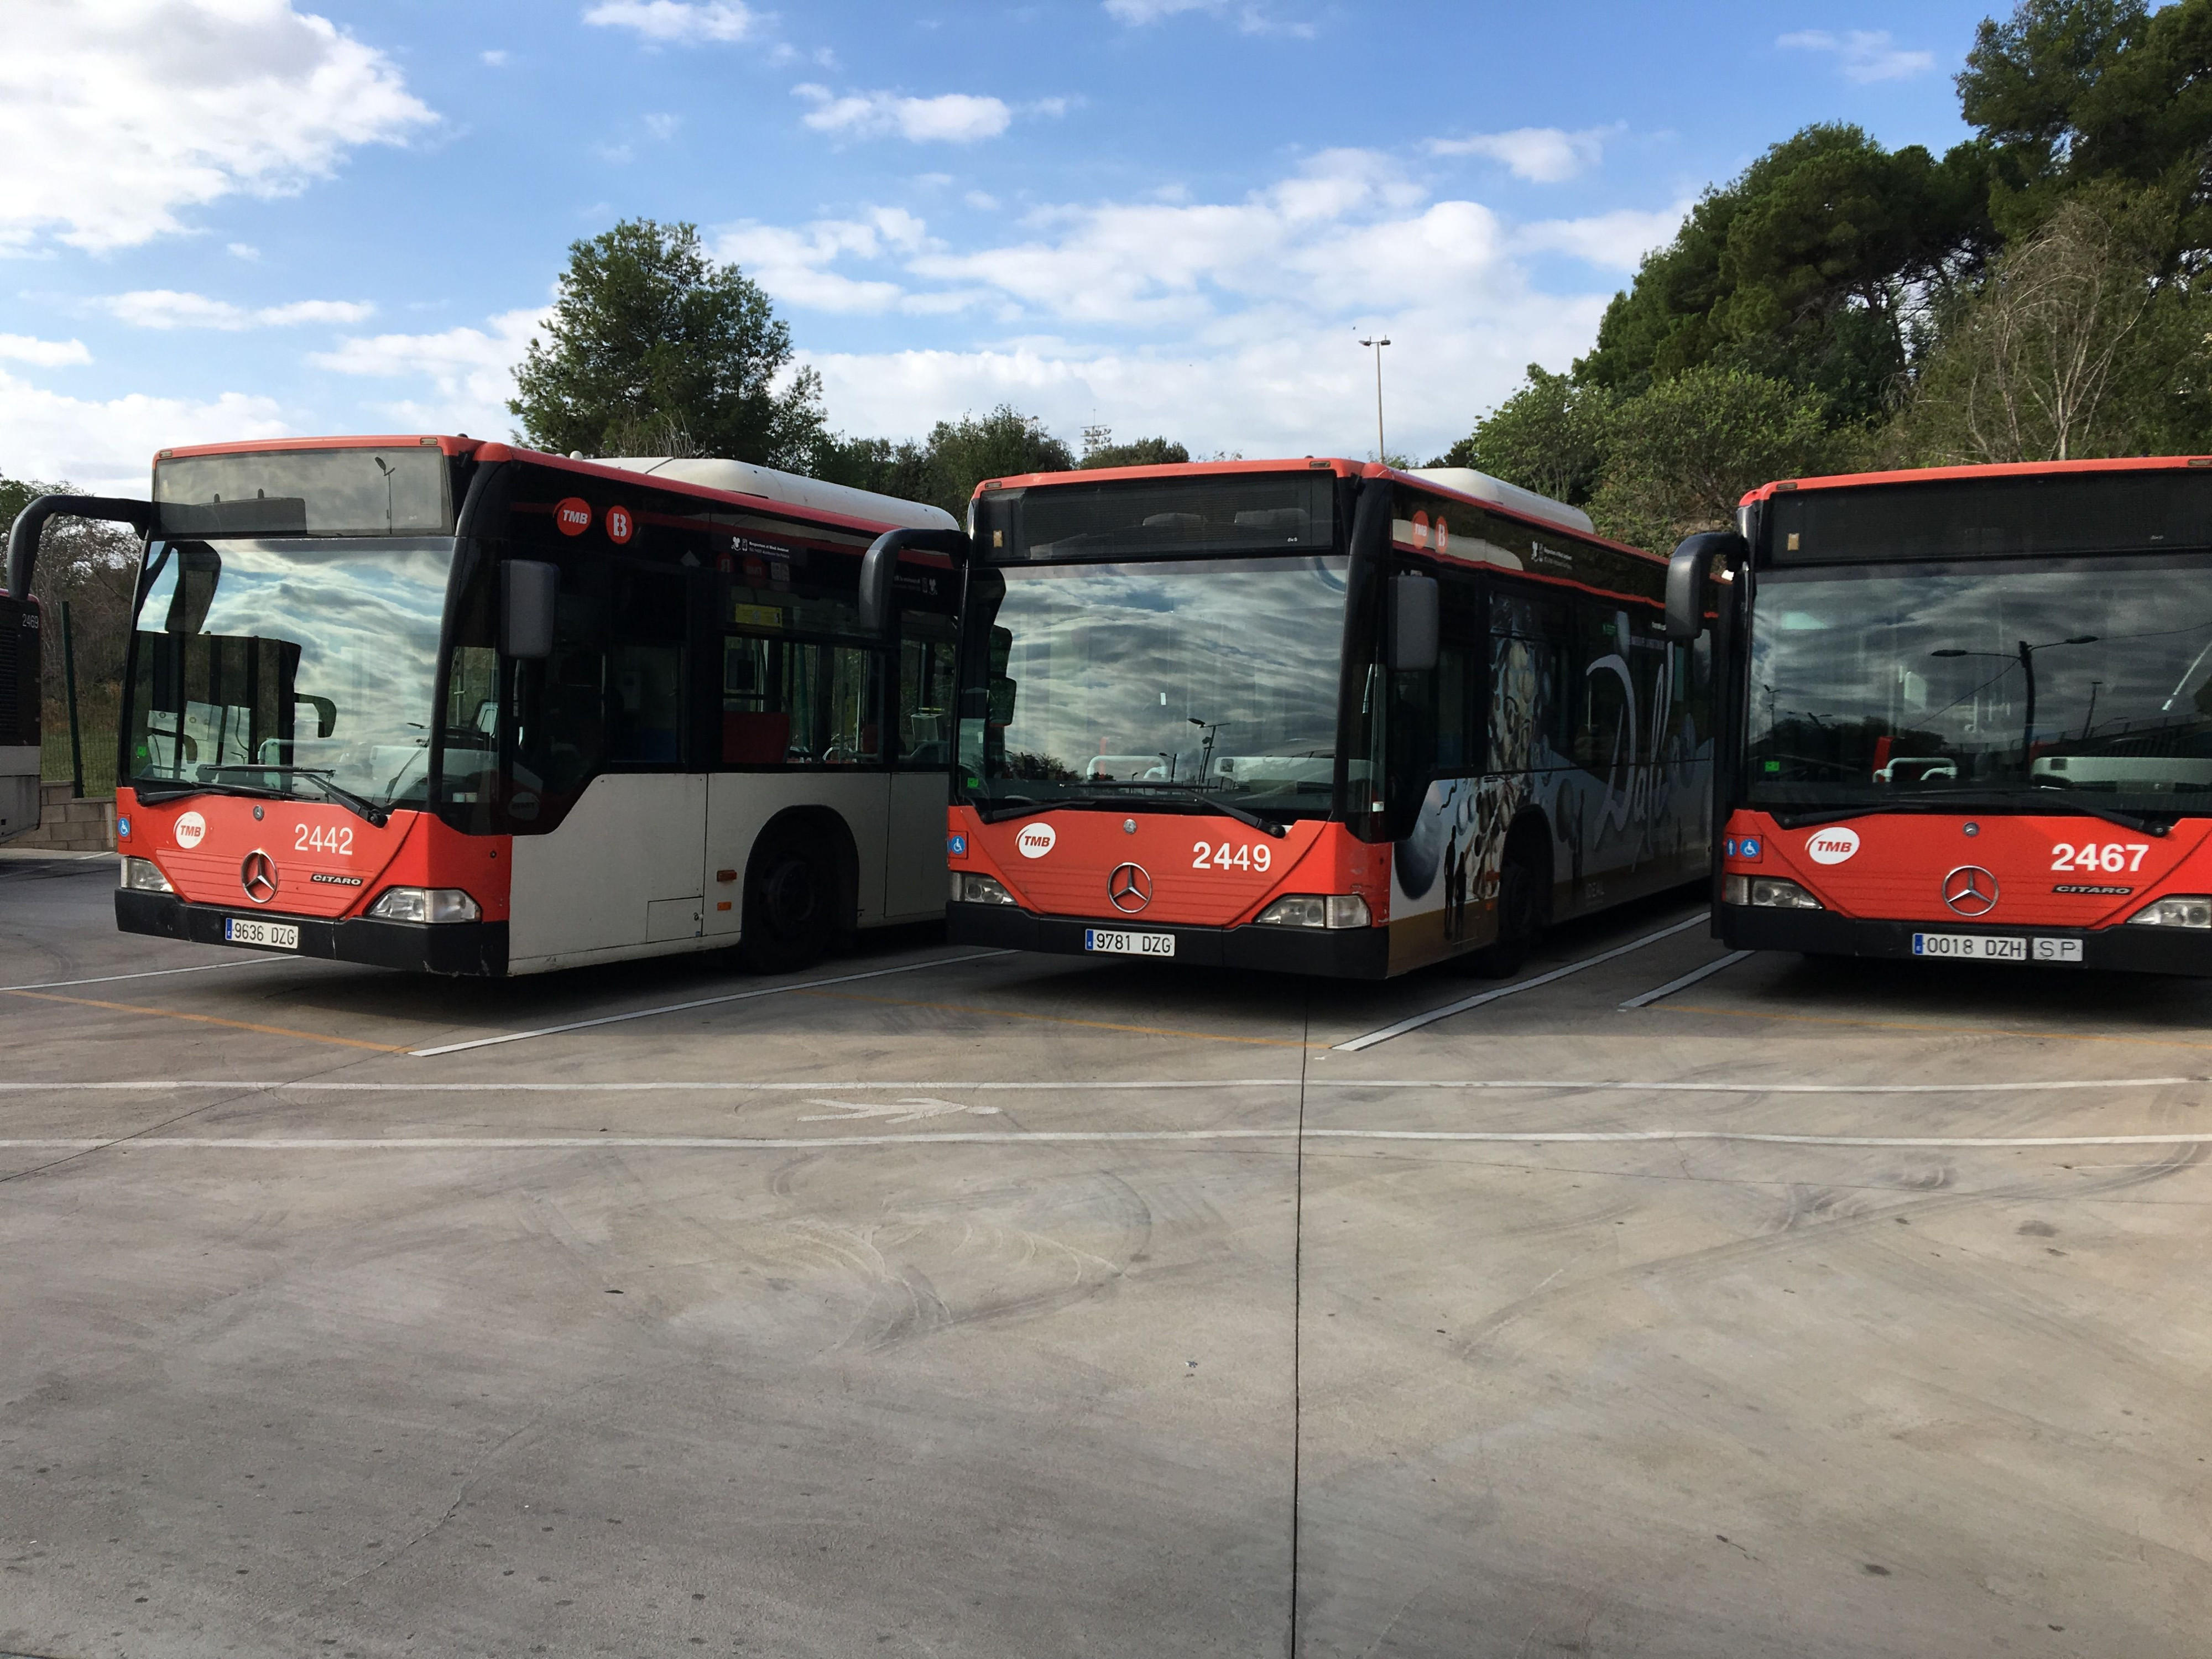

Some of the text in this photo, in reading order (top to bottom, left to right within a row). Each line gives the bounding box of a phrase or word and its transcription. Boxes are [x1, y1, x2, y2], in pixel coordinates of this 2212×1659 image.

[563, 509, 588, 524] TMB
[613, 513, 627, 537] B
[1438, 524, 1446, 547] B
[22, 613, 39, 629] 2469
[180, 825, 201, 837] TMB
[294, 823, 353, 855] 2442
[1025, 836, 1050, 847] TMB
[1818, 841, 1851, 852] TMB
[1192, 841, 1271, 872] 2449
[2051, 843, 2150, 872] 2467
[312, 875, 361, 885] CITARO
[234, 922, 264, 941] 9636
[271, 927, 295, 945] DZG
[1097, 933, 1130, 951] 9781
[1142, 936, 1171, 953] DZG
[1927, 937, 1974, 955] 0018
[1985, 940, 2022, 957] DZH
